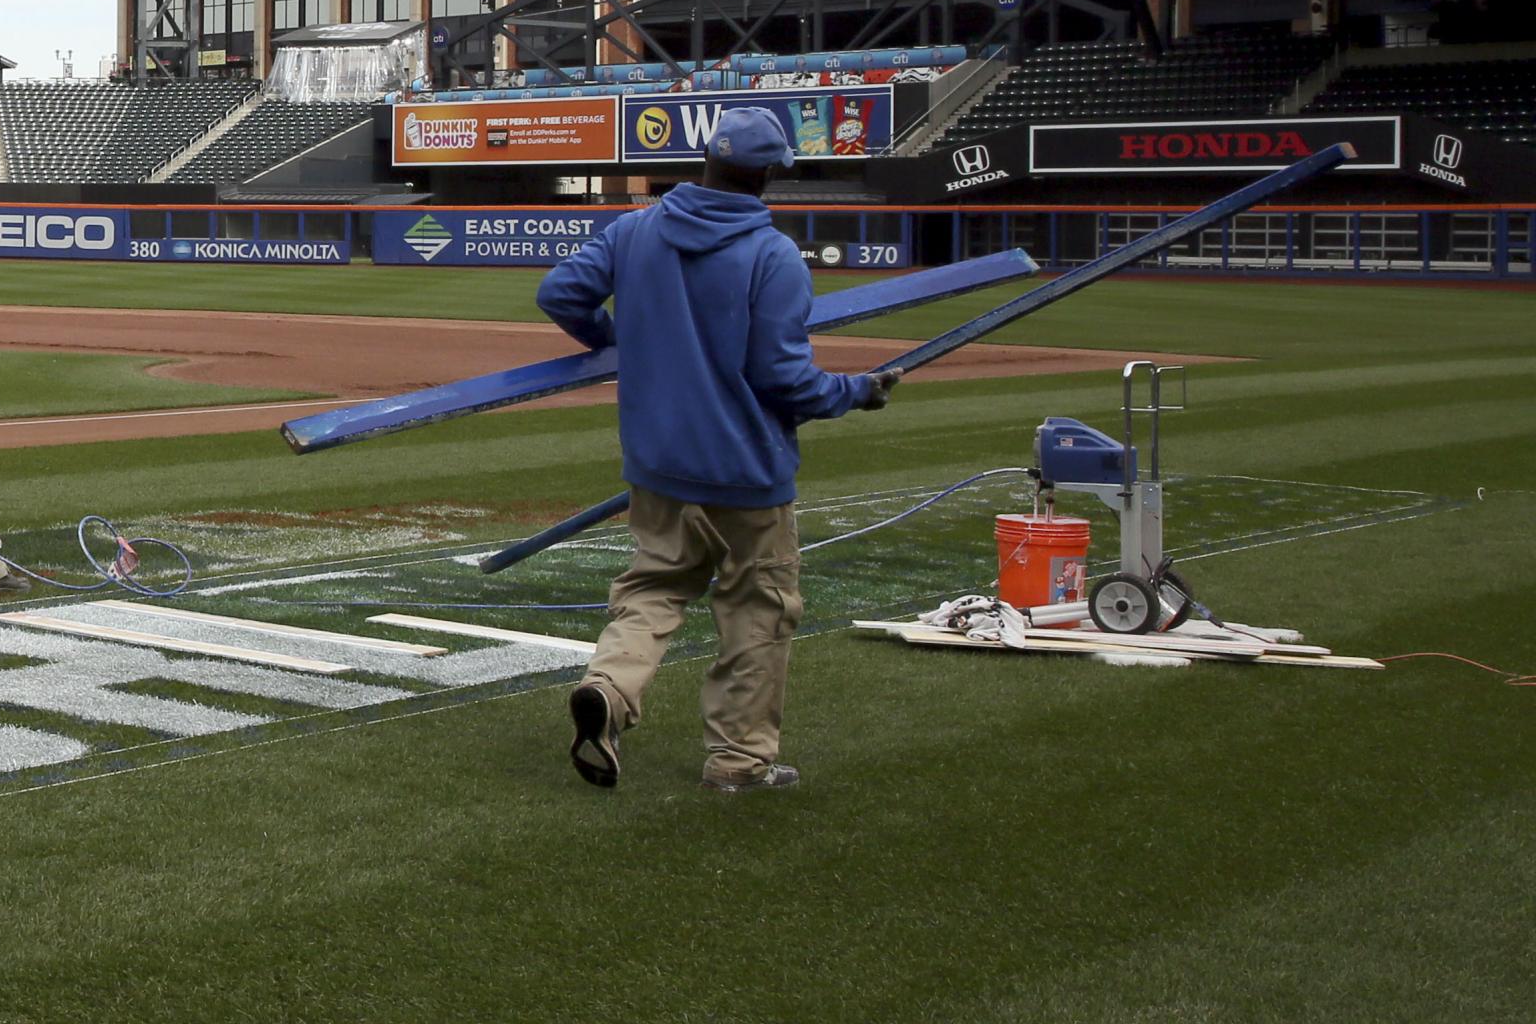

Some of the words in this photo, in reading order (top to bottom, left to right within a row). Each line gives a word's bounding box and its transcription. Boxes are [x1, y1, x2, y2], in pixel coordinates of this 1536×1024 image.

[760, 57, 776, 72] citi
[825, 54, 841, 69] citi
[892, 50, 909, 65] citi
[424, 119, 478, 133] DUNKIN'
[486, 118, 508, 126] FIRST
[533, 117, 539, 125] A
[541, 116, 561, 124] FREE
[562, 114, 605, 124] BEVERAGE
[424, 134, 476, 147] DONUTS
[1119, 131, 1313, 160] HONDA
[946, 168, 1009, 192] HONDA
[1419, 162, 1467, 187] HONDA
[465, 219, 518, 235] EAST
[523, 219, 594, 235] COAST
[129, 241, 160, 258] 380
[195, 242, 261, 259] KONICA
[264, 243, 340, 260] MINOLTA
[465, 241, 533, 257] POWER
[538, 241, 550, 257] &
[858, 246, 898, 264] 370
